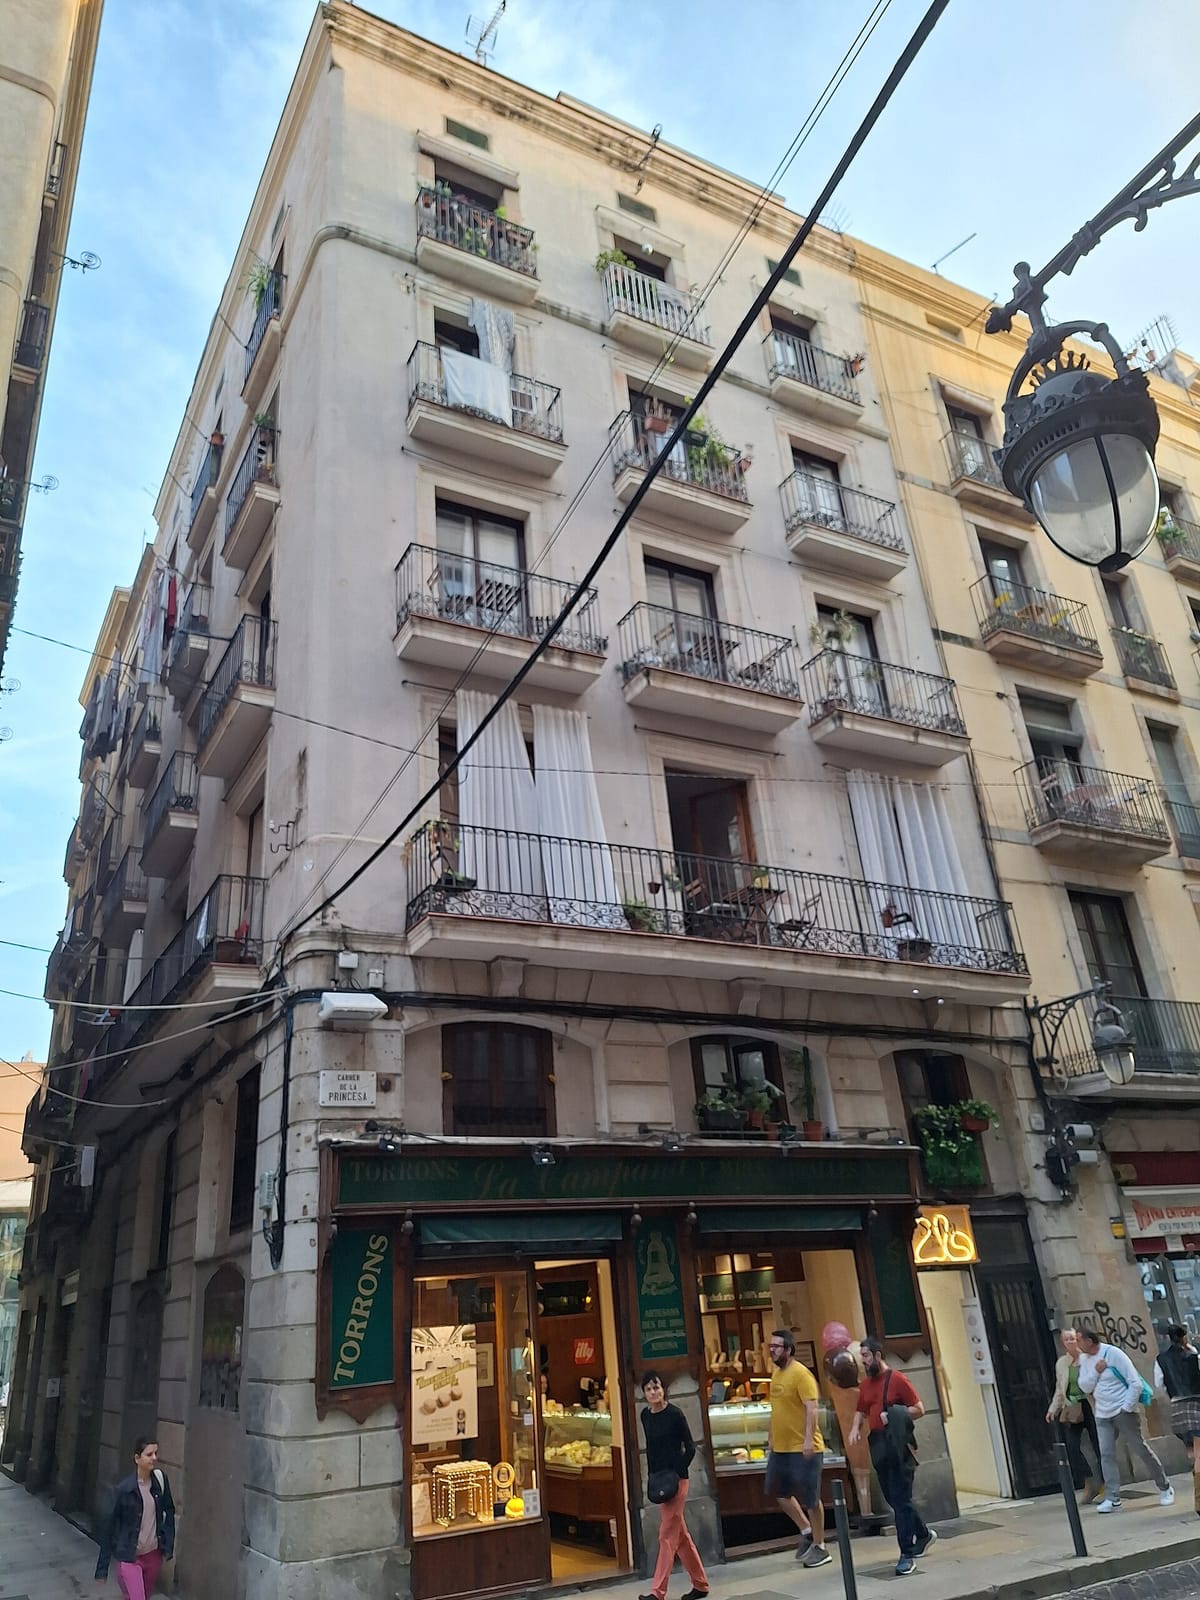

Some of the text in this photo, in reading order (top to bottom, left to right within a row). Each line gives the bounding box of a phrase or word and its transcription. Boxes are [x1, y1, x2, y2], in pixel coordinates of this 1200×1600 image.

[328, 1091, 368, 1101] PRINCESA
[340, 1083, 357, 1091] DE LA
[351, 1160, 460, 1183] TORRONS
[333, 1233, 389, 1382] TORRONS
[575, 1342, 594, 1361] illy
